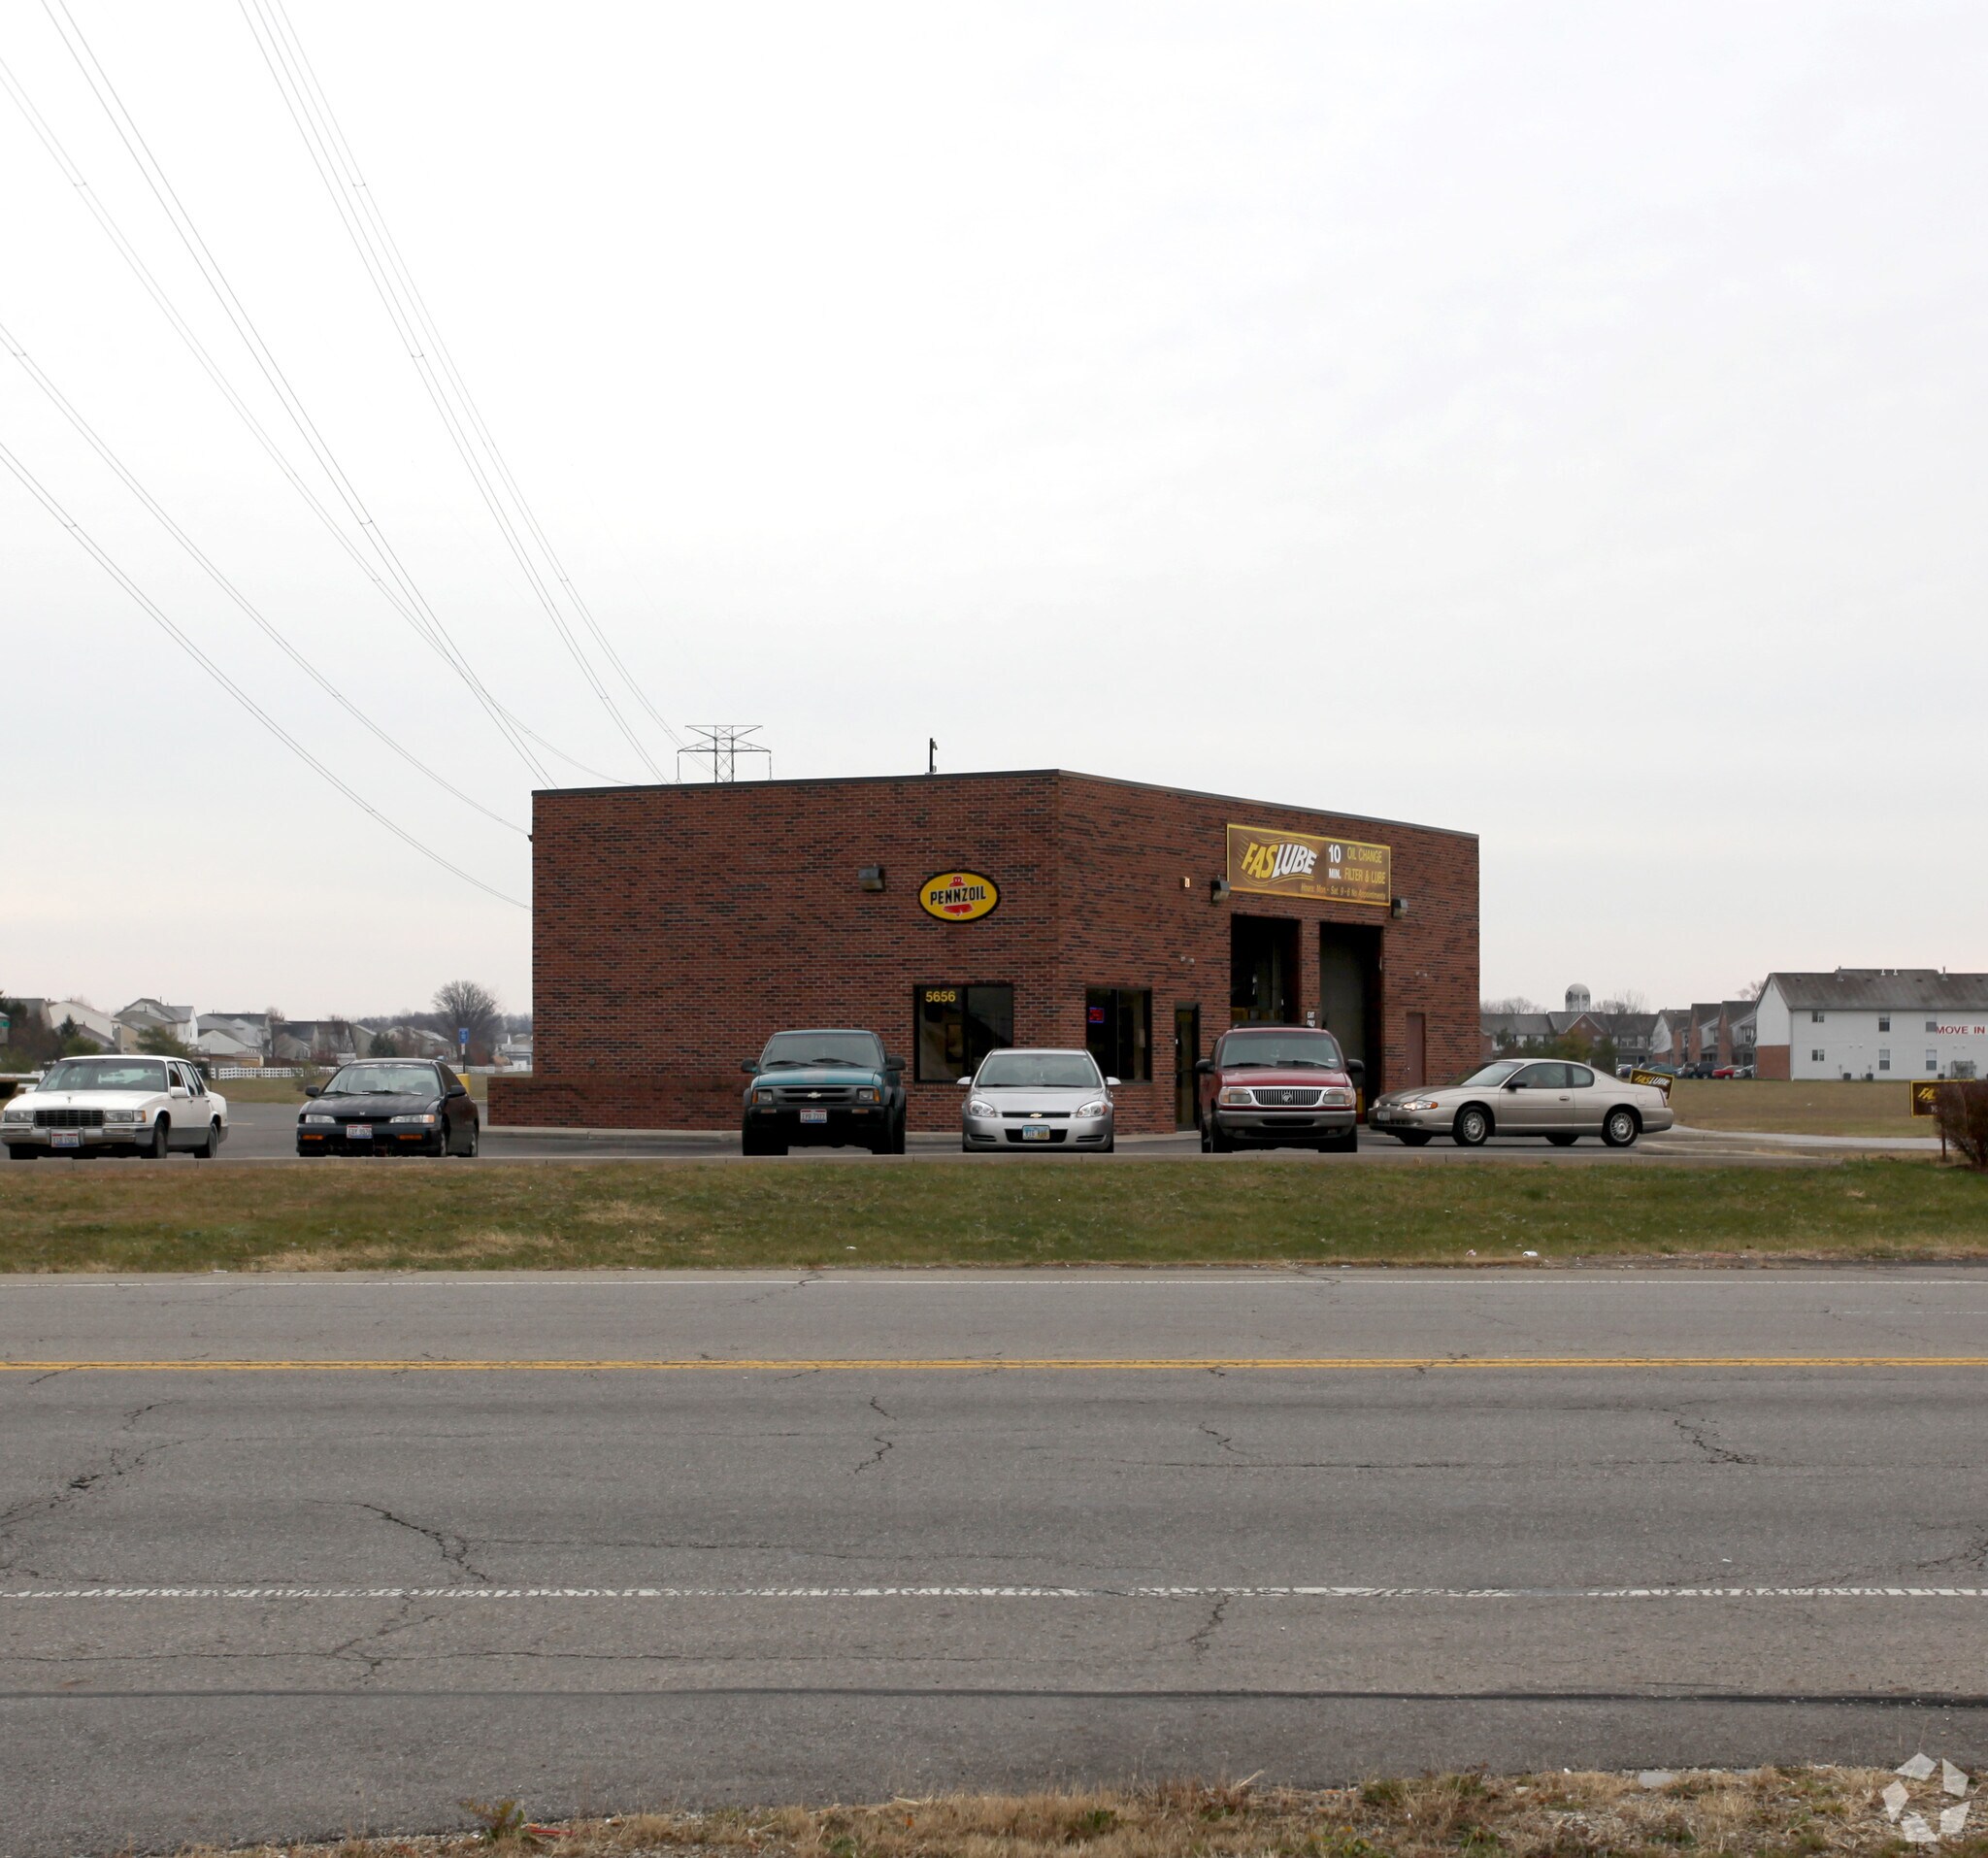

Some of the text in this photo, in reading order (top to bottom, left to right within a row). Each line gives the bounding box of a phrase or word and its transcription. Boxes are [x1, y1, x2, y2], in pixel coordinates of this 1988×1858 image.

[1241, 842, 1317, 879] FASLUBE
[1328, 844, 1342, 863] 10
[1347, 846, 1382, 863] OIL CHANGE
[1343, 867, 1386, 884] FILTER & LUBE
[930, 885, 986, 906] PENNZOIL
[925, 991, 956, 1003] 5656
[1937, 1025, 1985, 1035] MOVE IN
[1635, 1075, 1671, 1086] FASLUBE
